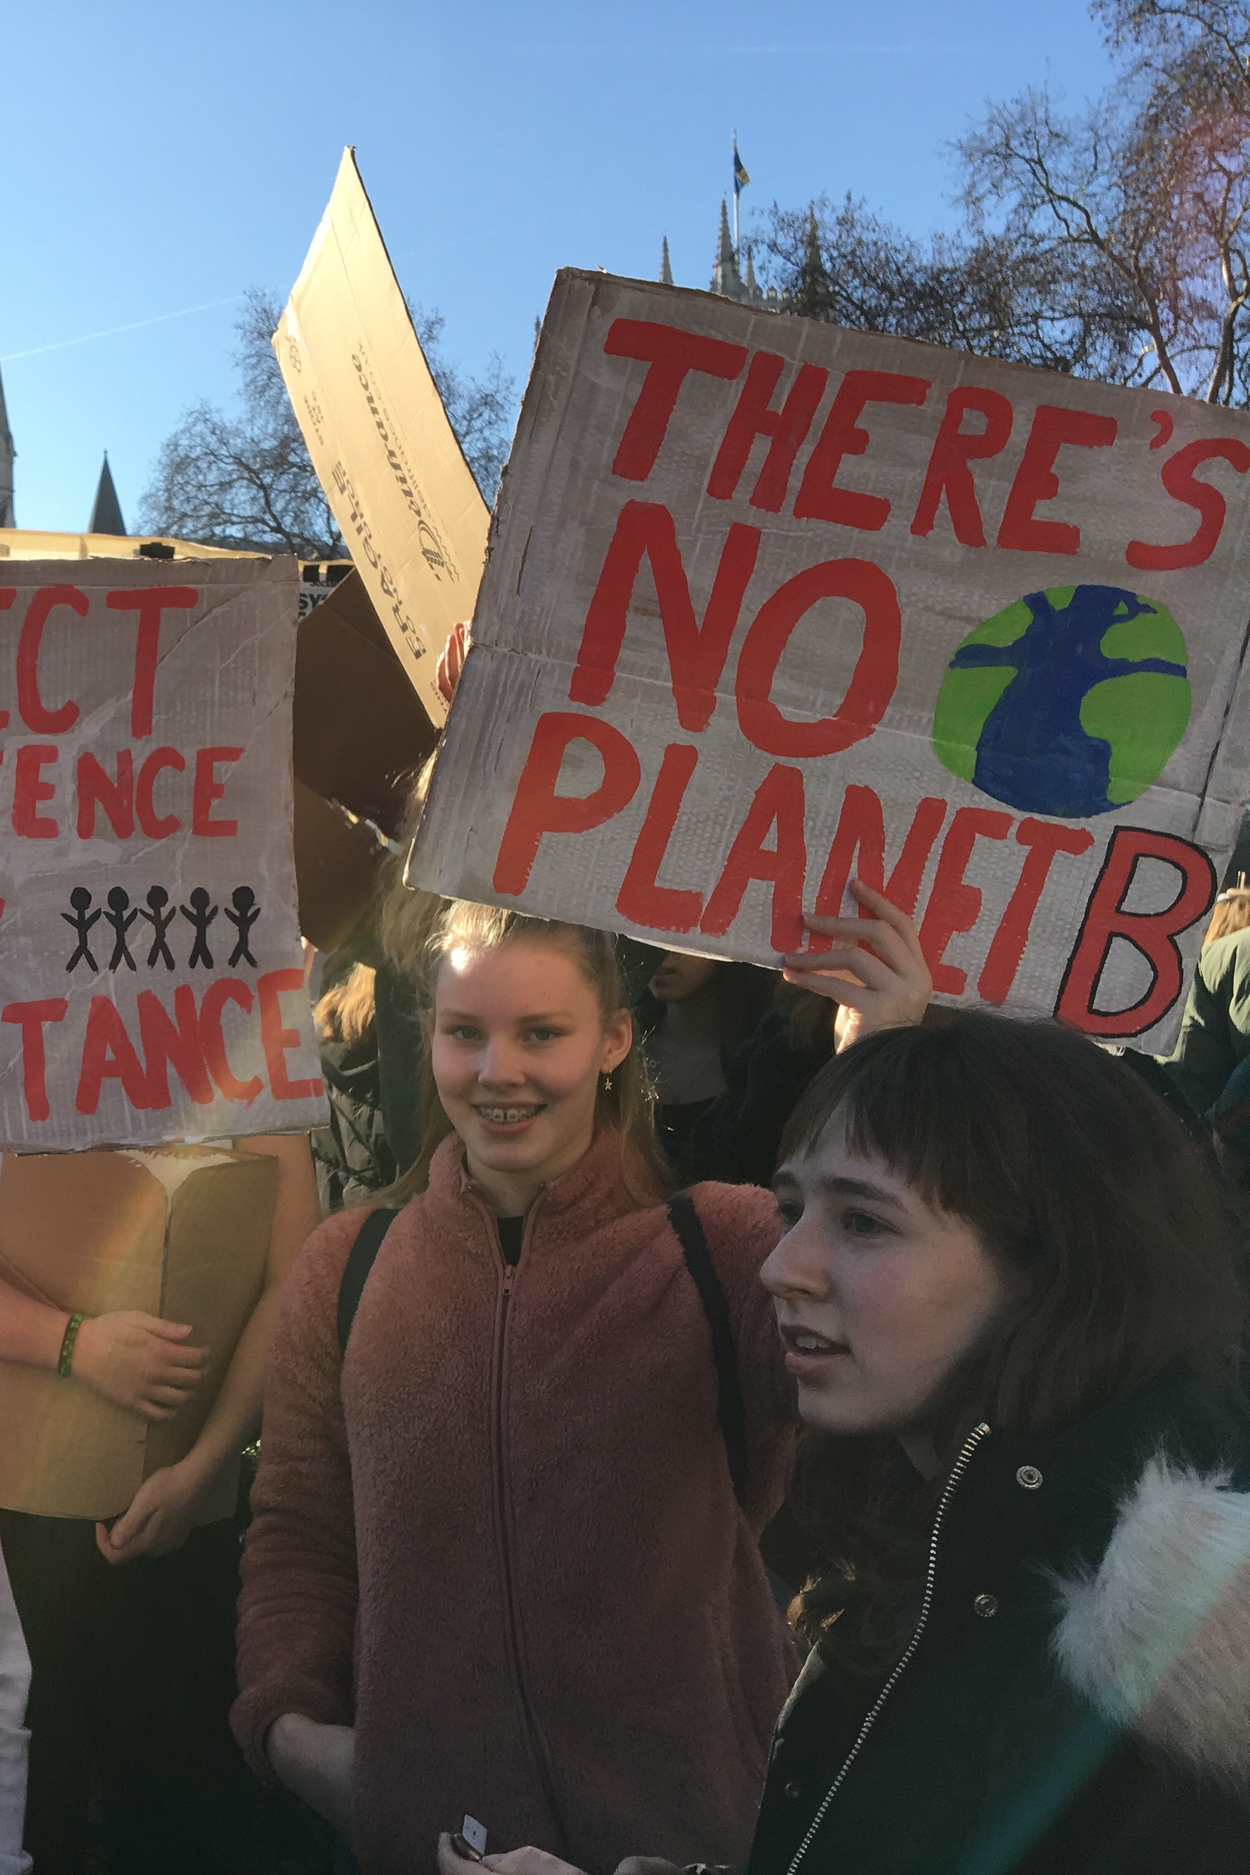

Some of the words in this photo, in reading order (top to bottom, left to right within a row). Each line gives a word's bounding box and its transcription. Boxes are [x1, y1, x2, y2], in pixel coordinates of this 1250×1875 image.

[331, 469, 423, 660] FRAGILE
[604, 317, 1250, 571] THERE'S
[568, 499, 902, 758] NO
[492, 711, 1095, 1007] PLANET
[1053, 825, 1218, 1039] B
